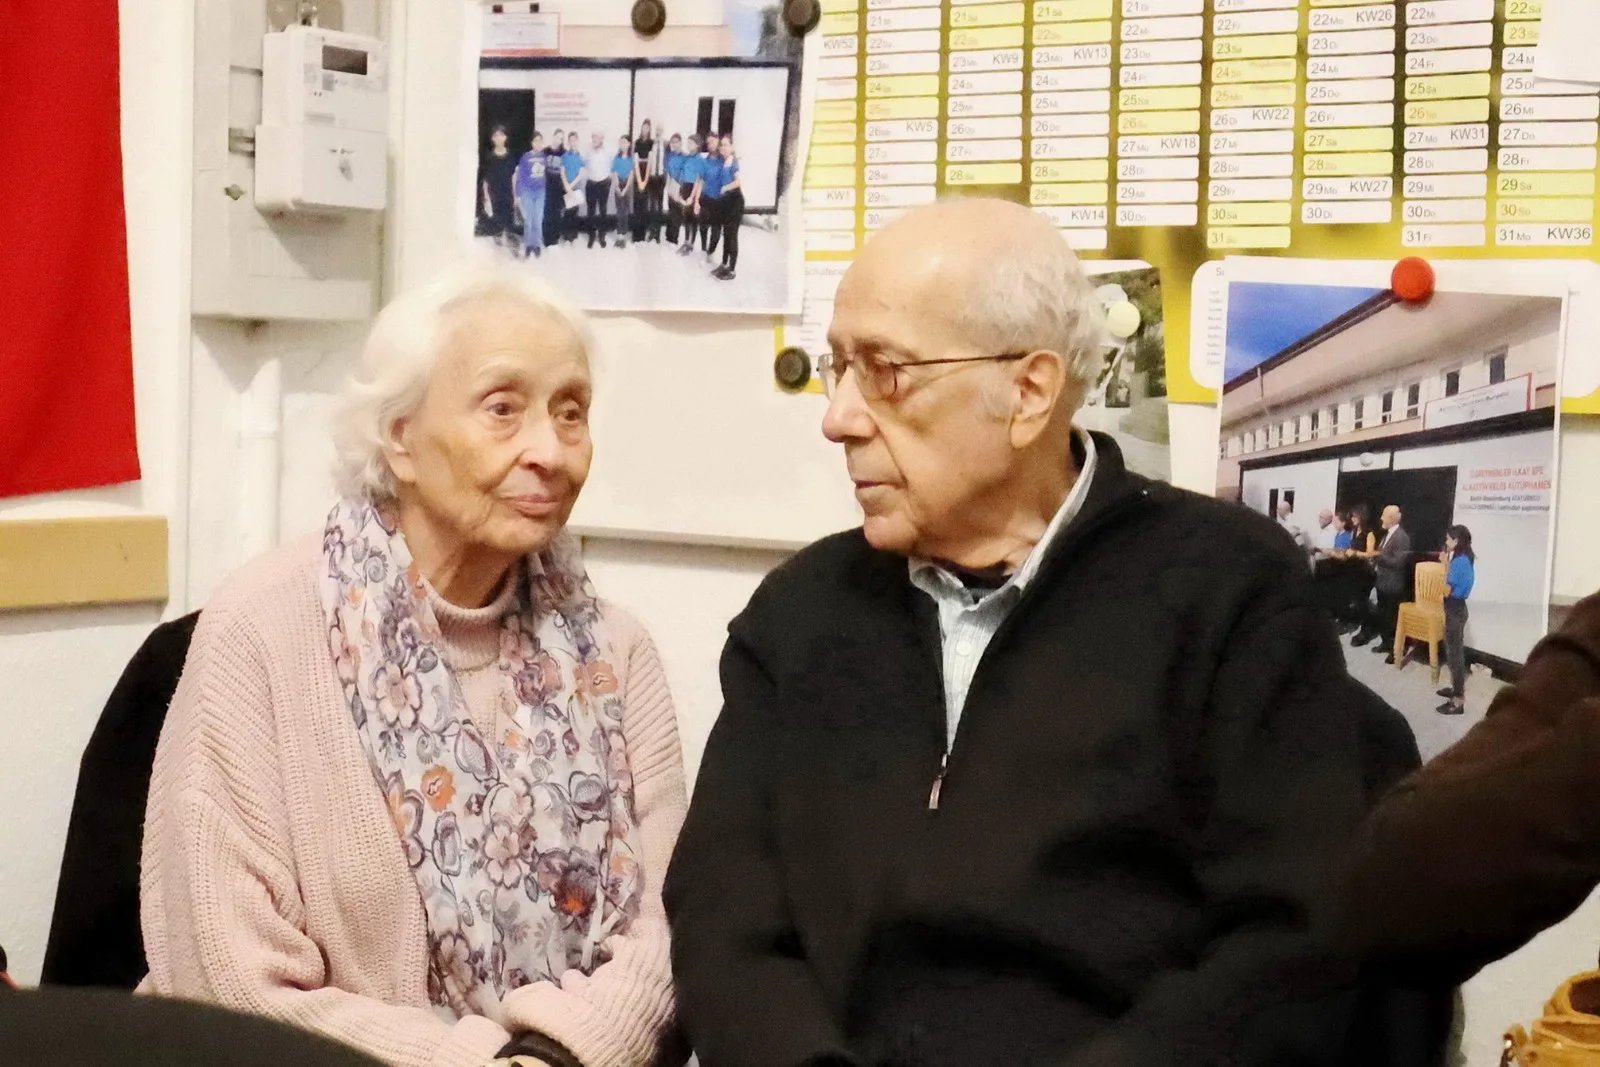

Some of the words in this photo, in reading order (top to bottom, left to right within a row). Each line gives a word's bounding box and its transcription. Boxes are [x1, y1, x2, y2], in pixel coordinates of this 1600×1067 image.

[1356, 9, 1392, 22] KW26
[823, 37, 855, 49] KW52
[992, 53, 1019, 65] KW9
[1073, 47, 1108, 59] KW13
[1253, 108, 1290, 120] KW22
[906, 121, 933, 132] KW5
[1450, 128, 1485, 140] KW31
[1161, 137, 1196, 149] KW18
[1350, 181, 1388, 192] KW27
[826, 190, 850, 201] KW1
[1071, 209, 1104, 221] KW14
[1547, 228, 1591, 239] KW36
